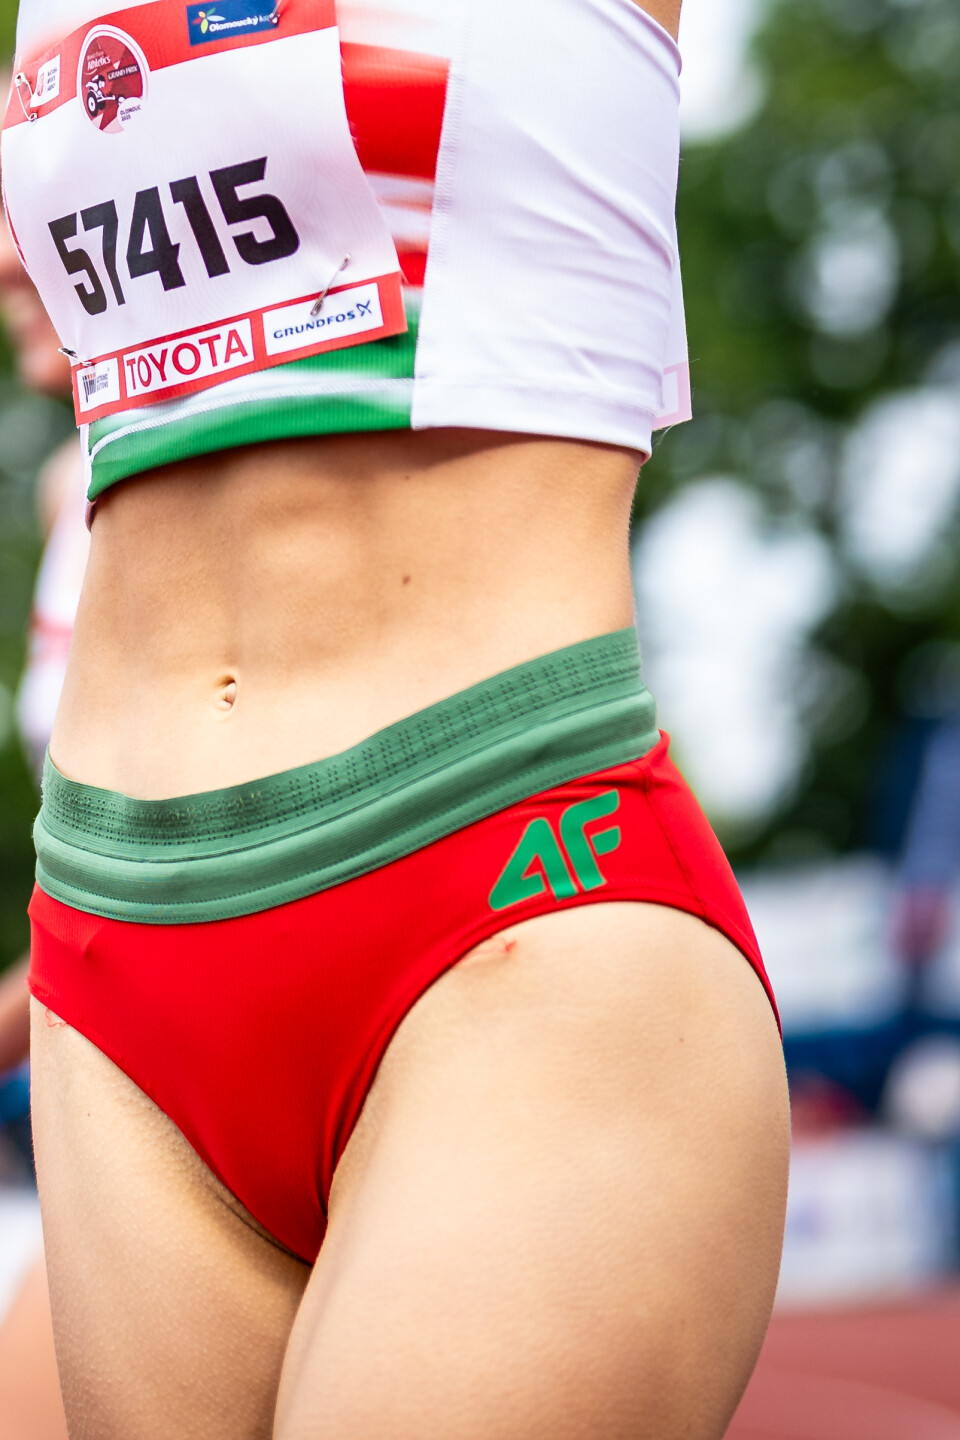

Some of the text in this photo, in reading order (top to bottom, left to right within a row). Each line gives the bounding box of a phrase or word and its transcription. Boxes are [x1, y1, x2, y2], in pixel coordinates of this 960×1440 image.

[48, 156, 300, 316] 57415
[126, 329, 248, 390] TOYOTA
[273, 310, 356, 339] GRUNDFOS
[488, 788, 621, 911] 4F
